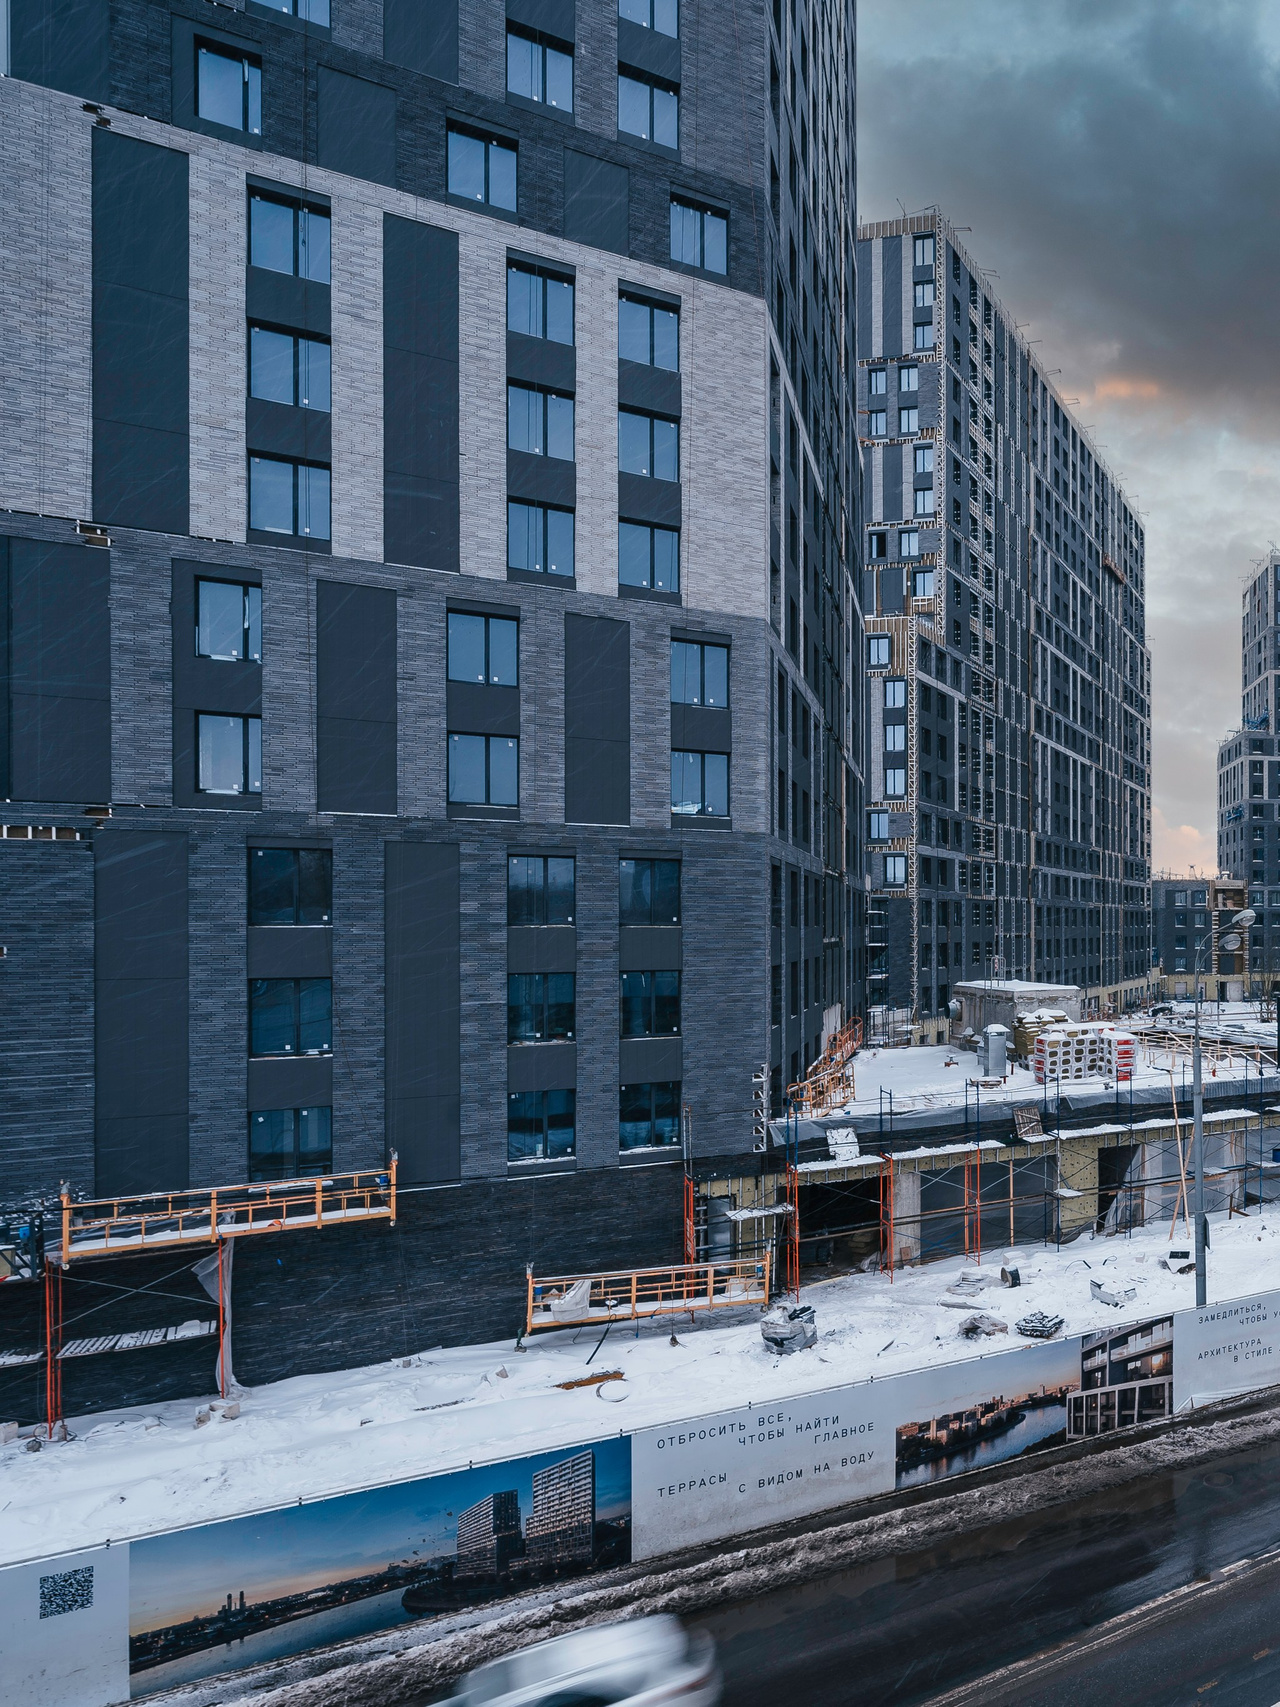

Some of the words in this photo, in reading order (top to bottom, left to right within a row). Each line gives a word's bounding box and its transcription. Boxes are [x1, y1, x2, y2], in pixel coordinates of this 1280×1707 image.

[1198, 1303, 1267, 1325] ЗАМЕДЛИТЬСЯ,
[1239, 1313, 1268, 1326] ЧТОБЫ
[1198, 1338, 1262, 1361] АРХИТЕКТУРА
[1233, 1355, 1239, 1363] В
[1244, 1346, 1273, 1360] СТИЛЕ
[657, 1421, 746, 1449] ОТБРОСИТЬ
[758, 1412, 793, 1427] ВСЕ,
[738, 1427, 785, 1446] ЧТОБЫ
[795, 1415, 840, 1434] НАЙТИ
[814, 1422, 875, 1444] ГЛАВНОЕ
[738, 1483, 746, 1493] С
[758, 1468, 803, 1488] ВИДОМ
[814, 1461, 831, 1474] НА
[841, 1451, 875, 1468] ВОДУ
[657, 1472, 728, 1498] ТЕРРАСЫ
